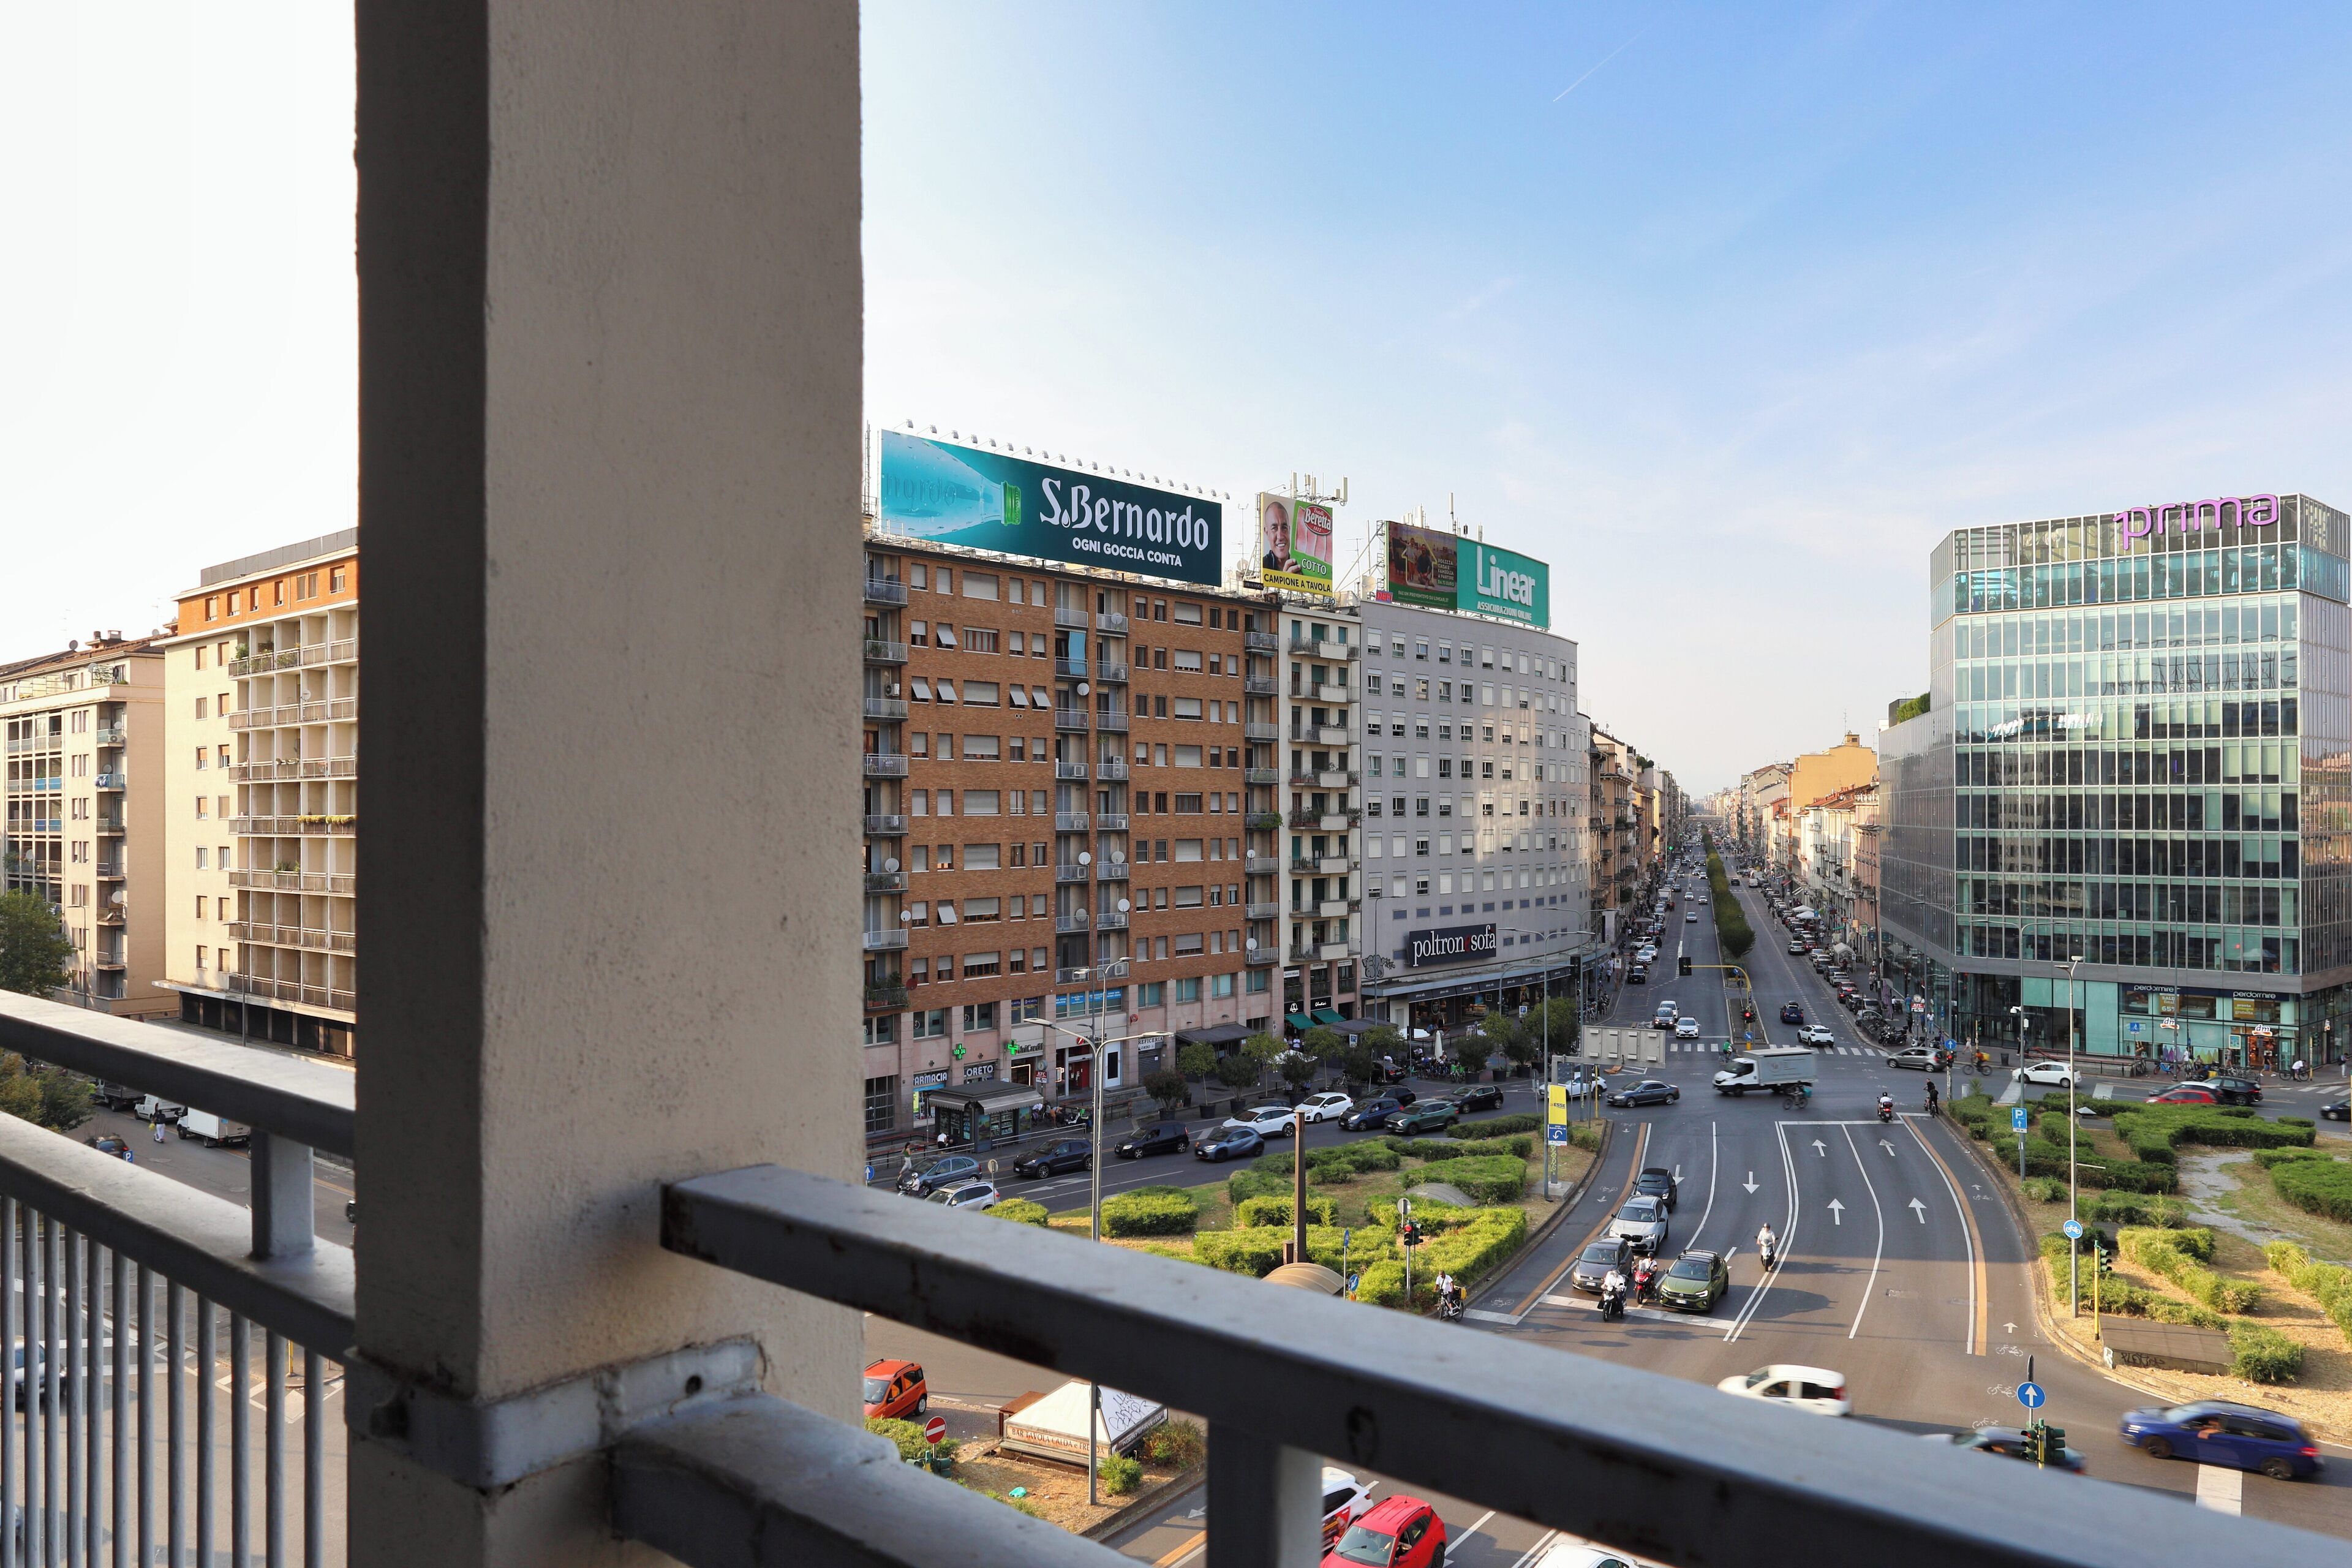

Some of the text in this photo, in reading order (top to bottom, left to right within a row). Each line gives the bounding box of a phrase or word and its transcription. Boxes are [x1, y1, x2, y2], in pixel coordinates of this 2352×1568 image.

[1040, 478, 1208, 551] S.Bernardo
[1305, 509, 1331, 530] Beretta
[2113, 493, 2278, 550] prima
[1072, 537, 1182, 567] OGNI GOCCIA CONTA
[1302, 558, 1327, 575] COTTO
[1477, 545, 1536, 606] Linear
[1264, 574, 1299, 587] CAMPIONE
[1306, 581, 1332, 592] TAVOLA.
[1477, 601, 1532, 621] ASSICURAZIONI ONLINE
[1018, 1042, 1043, 1054] UniCredit
[913, 1072, 948, 1085] ARMACIA
[2015, 1109, 2024, 1119] P
[126, 1152, 131, 1162] P
[1012, 1428, 1023, 1437] BAR
[1025, 1431, 1050, 1442] TAVOLA
[1052, 1438, 1072, 1448] CALDA
[1079, 1442, 1104, 1454] FREDA
